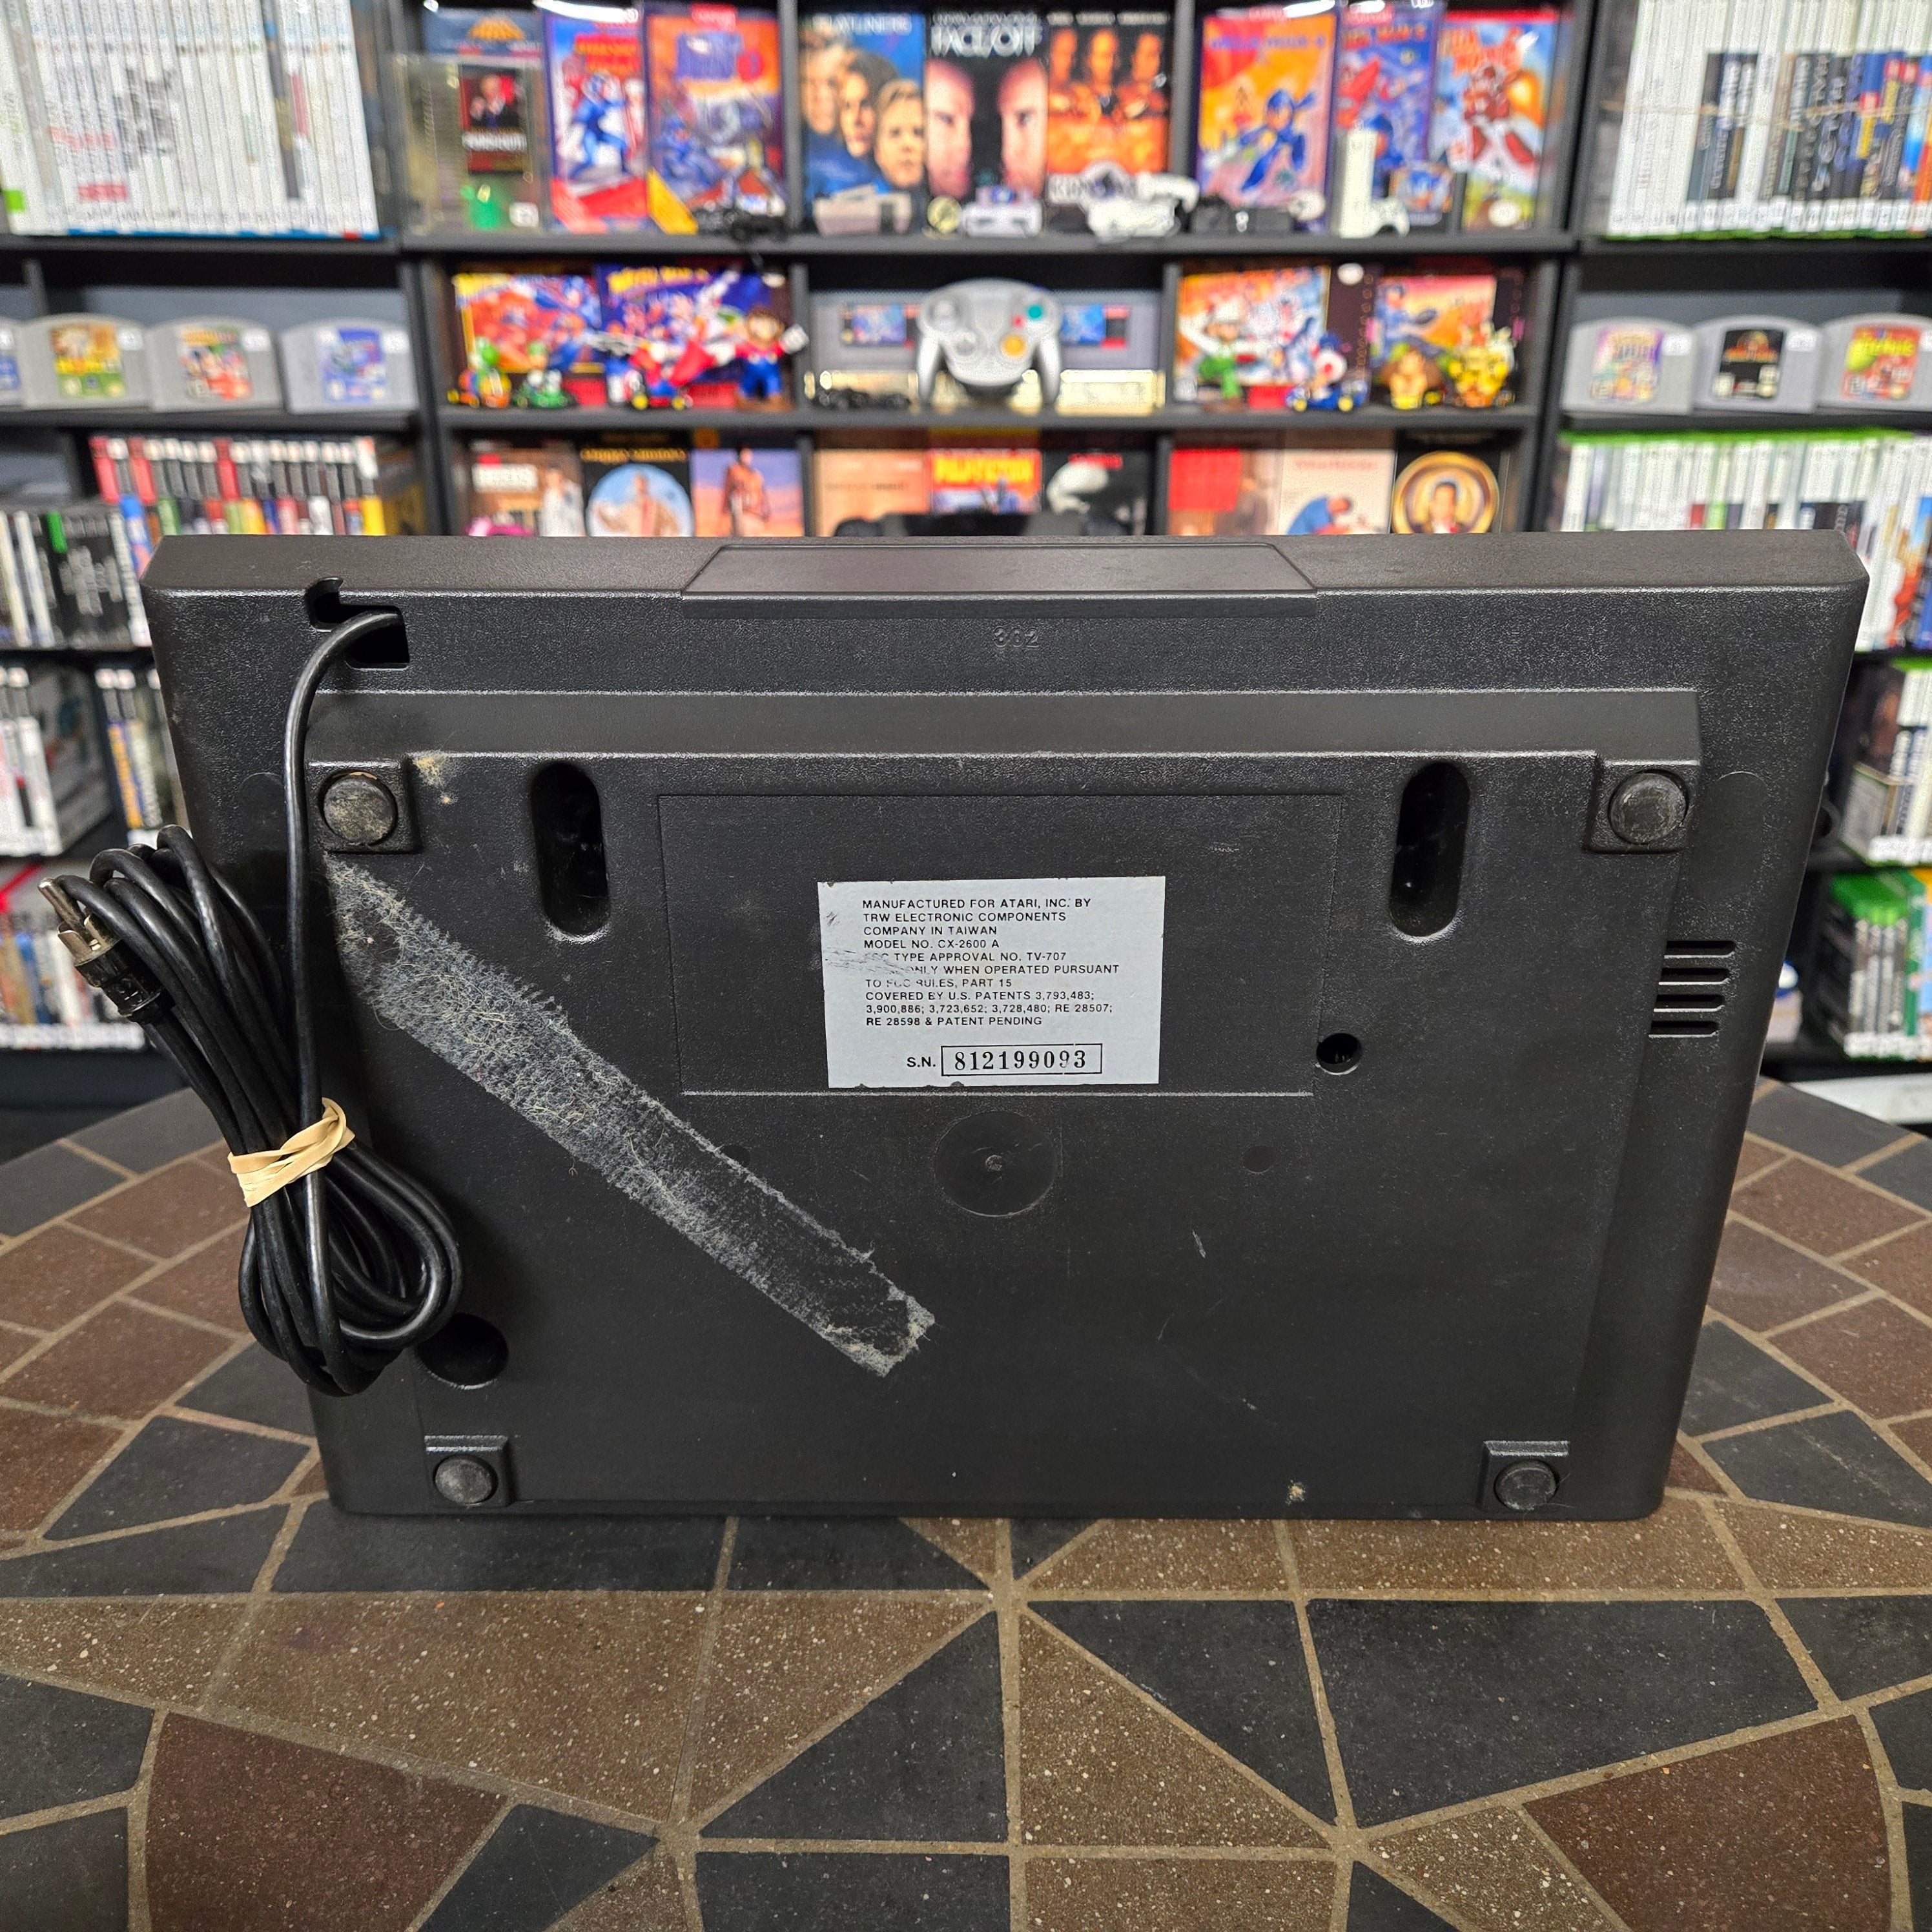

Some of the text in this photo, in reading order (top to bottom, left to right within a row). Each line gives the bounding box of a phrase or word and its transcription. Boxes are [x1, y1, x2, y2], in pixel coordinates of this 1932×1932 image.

[862, 898, 1091, 909] MANUFACTURED FOR ATARI, INC. BY
[863, 912, 1066, 922] TRW ELECTRONIC COMPONENTS
[863, 926, 997, 936] COMPANY IN TAIWAN
[864, 939, 1000, 949] MODEL NO. CX-2600 A
[894, 952, 925, 961] TYPE
[929, 952, 995, 961] APPROVAL
[1000, 952, 1022, 961] NO.
[1026, 952, 1067, 961] TV-707
[906, 965, 938, 974] NLY
[943, 965, 980, 974] WHEN
[984, 965, 1049, 974] OPERATED
[1054, 964, 1120, 974] PURSUANT
[865, 979, 881, 988] TO
[916, 978, 958, 989] RULES,
[962, 978, 994, 987] PART
[999, 978, 1012, 987] 15
[865, 991, 1094, 1001] COVERED BY U.S. PATENTS 3,793,483;
[866, 1004, 925, 1014] 3,900,886;
[992, 1004, 1050, 1014] 3,728,480;
[1054, 1003, 1070, 1012] RE
[1074, 1003, 1112, 1013] 28507;
[866, 1016, 1042, 1026] RE 28598 & PATENT PENDING
[906, 1050, 1086, 1071] S.N. 812199093
